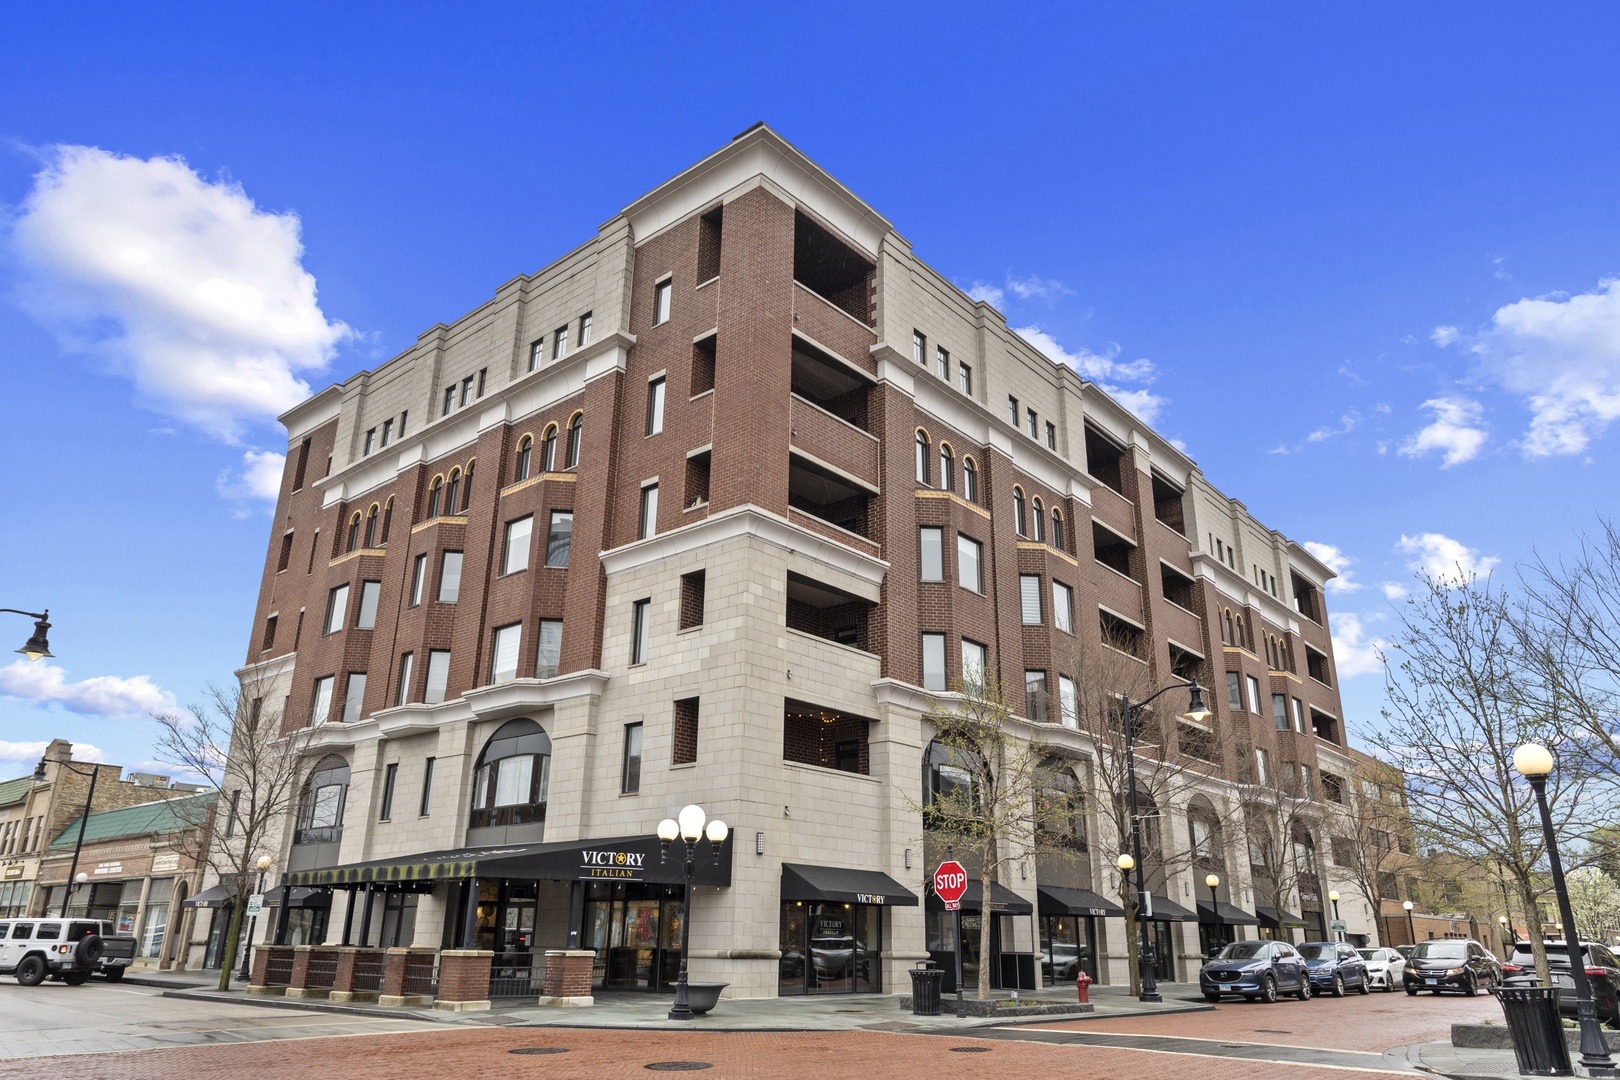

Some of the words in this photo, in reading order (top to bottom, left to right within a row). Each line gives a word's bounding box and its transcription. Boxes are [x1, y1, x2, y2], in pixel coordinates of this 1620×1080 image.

[582, 850, 645, 866] VICTORY
[591, 869, 633, 877] ITALIAN
[937, 873, 964, 889] STOP
[857, 893, 885, 904] VICTORY
[820, 920, 842, 928] VICTORY
